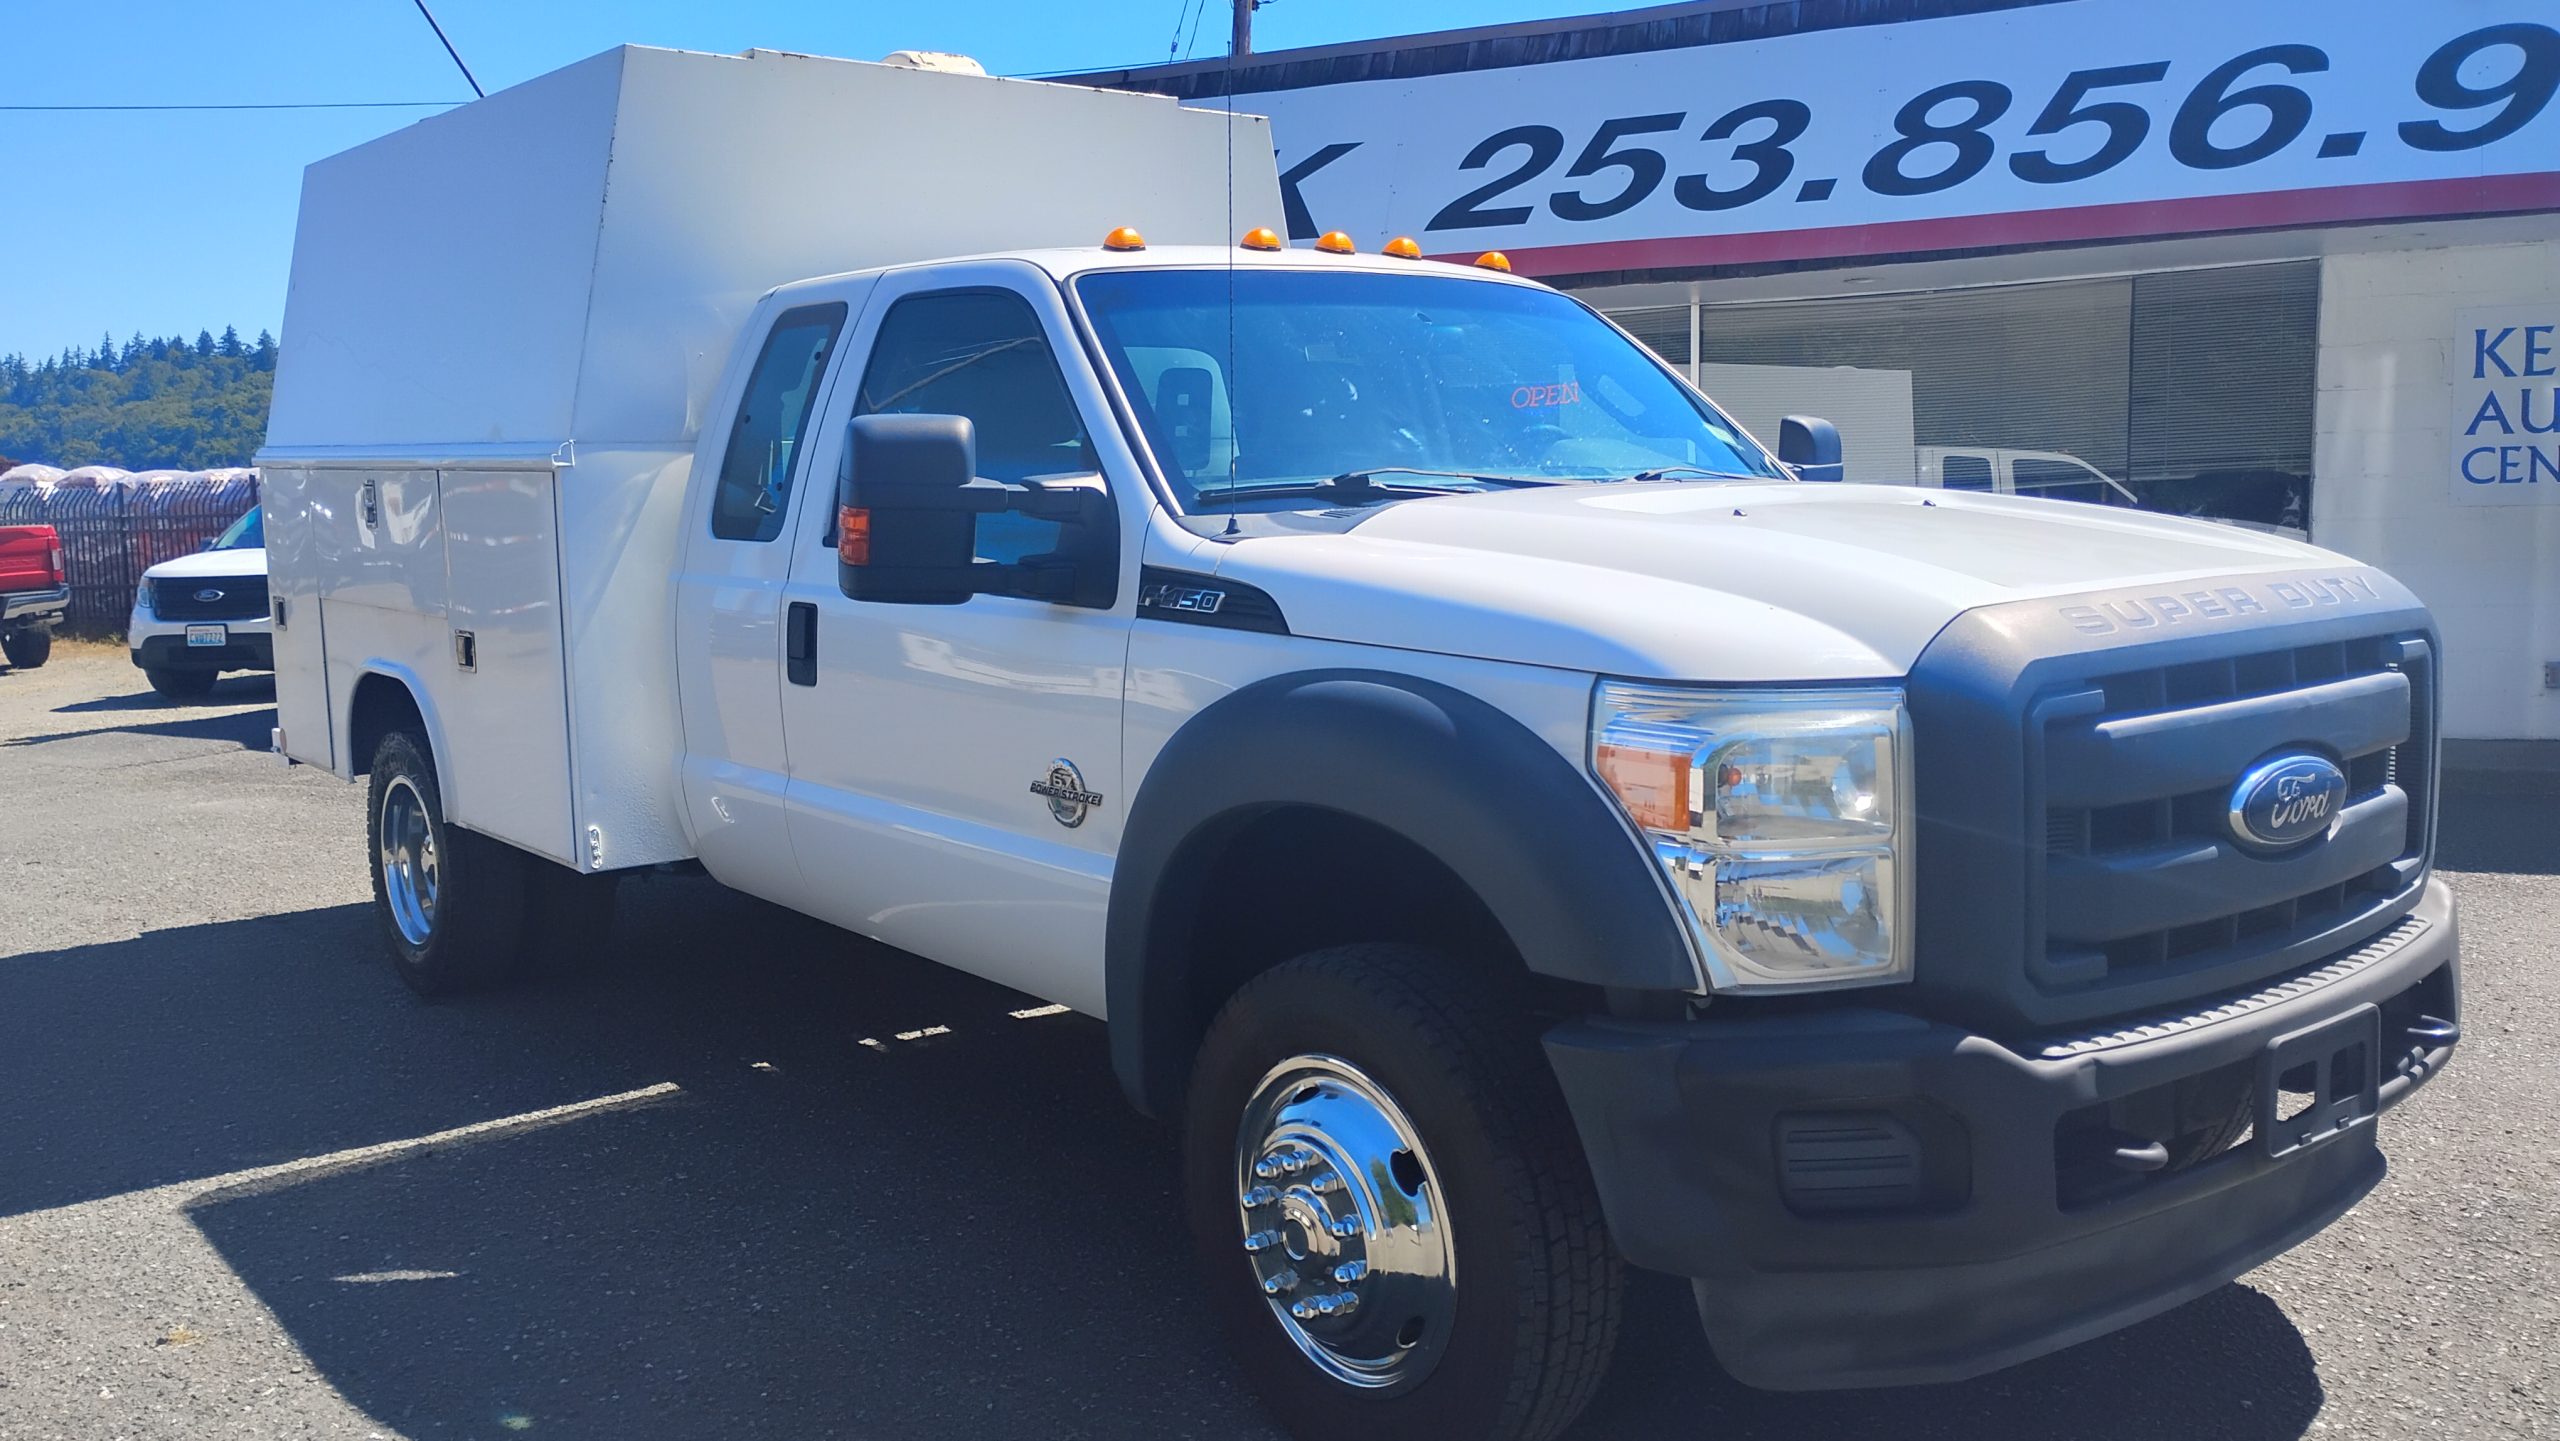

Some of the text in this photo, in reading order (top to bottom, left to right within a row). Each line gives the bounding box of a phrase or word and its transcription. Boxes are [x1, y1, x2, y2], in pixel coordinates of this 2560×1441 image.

[1424, 22, 2560, 232] 253.856.9
[2472, 325, 2557, 379] KE
[1511, 381, 1580, 409] OPEN
[2463, 387, 2560, 436] AU
[2460, 445, 2560, 485] CEN
[2058, 574, 2381, 637] SUPER DUTY
[2271, 772, 2331, 829] Ford
